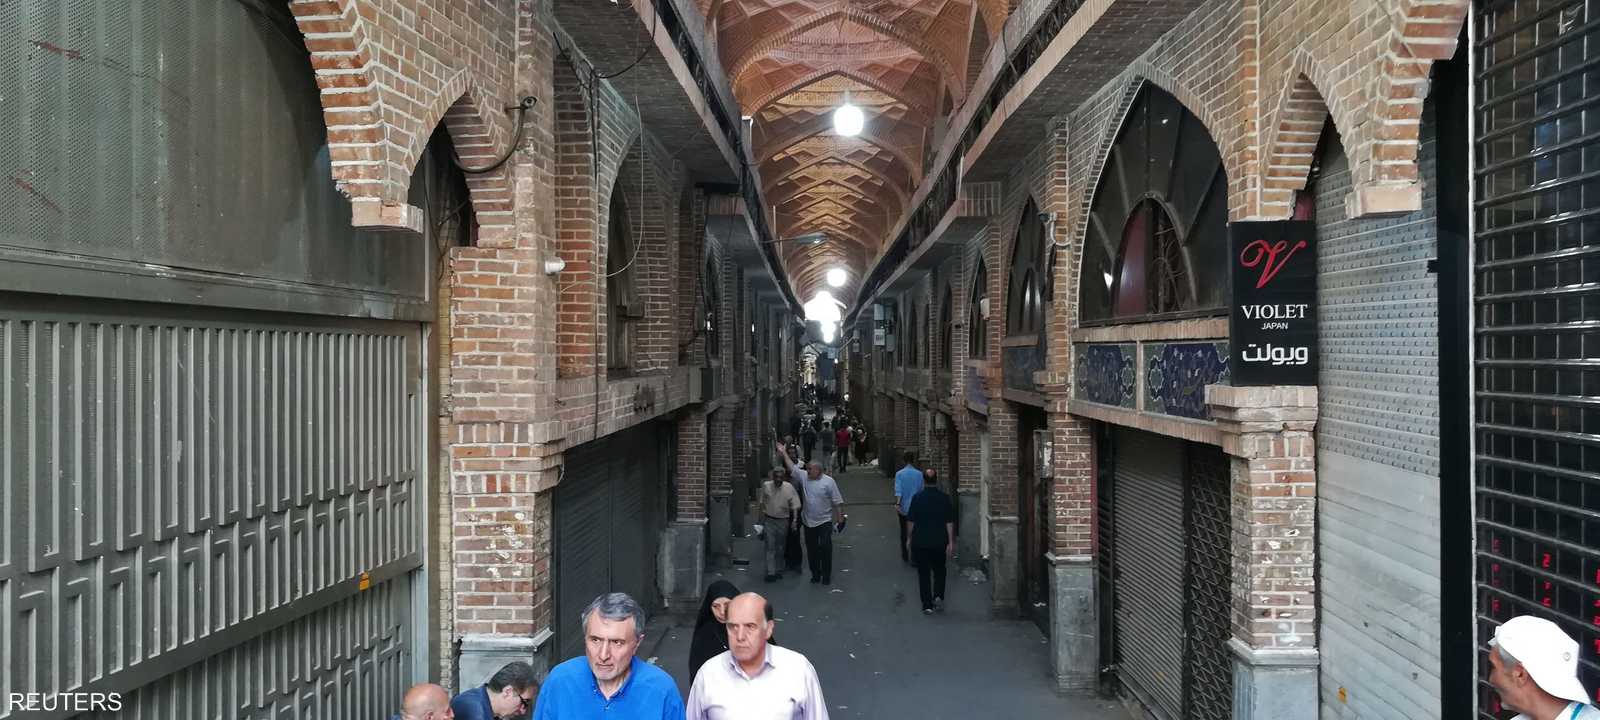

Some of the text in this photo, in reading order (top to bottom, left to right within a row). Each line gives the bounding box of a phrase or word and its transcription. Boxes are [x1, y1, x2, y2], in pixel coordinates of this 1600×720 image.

[1240, 239, 1309, 289] V
[1240, 304, 1309, 319] VIOLET
[1261, 322, 1289, 330] JAPAN
[1242, 343, 1309, 365] ويولت
